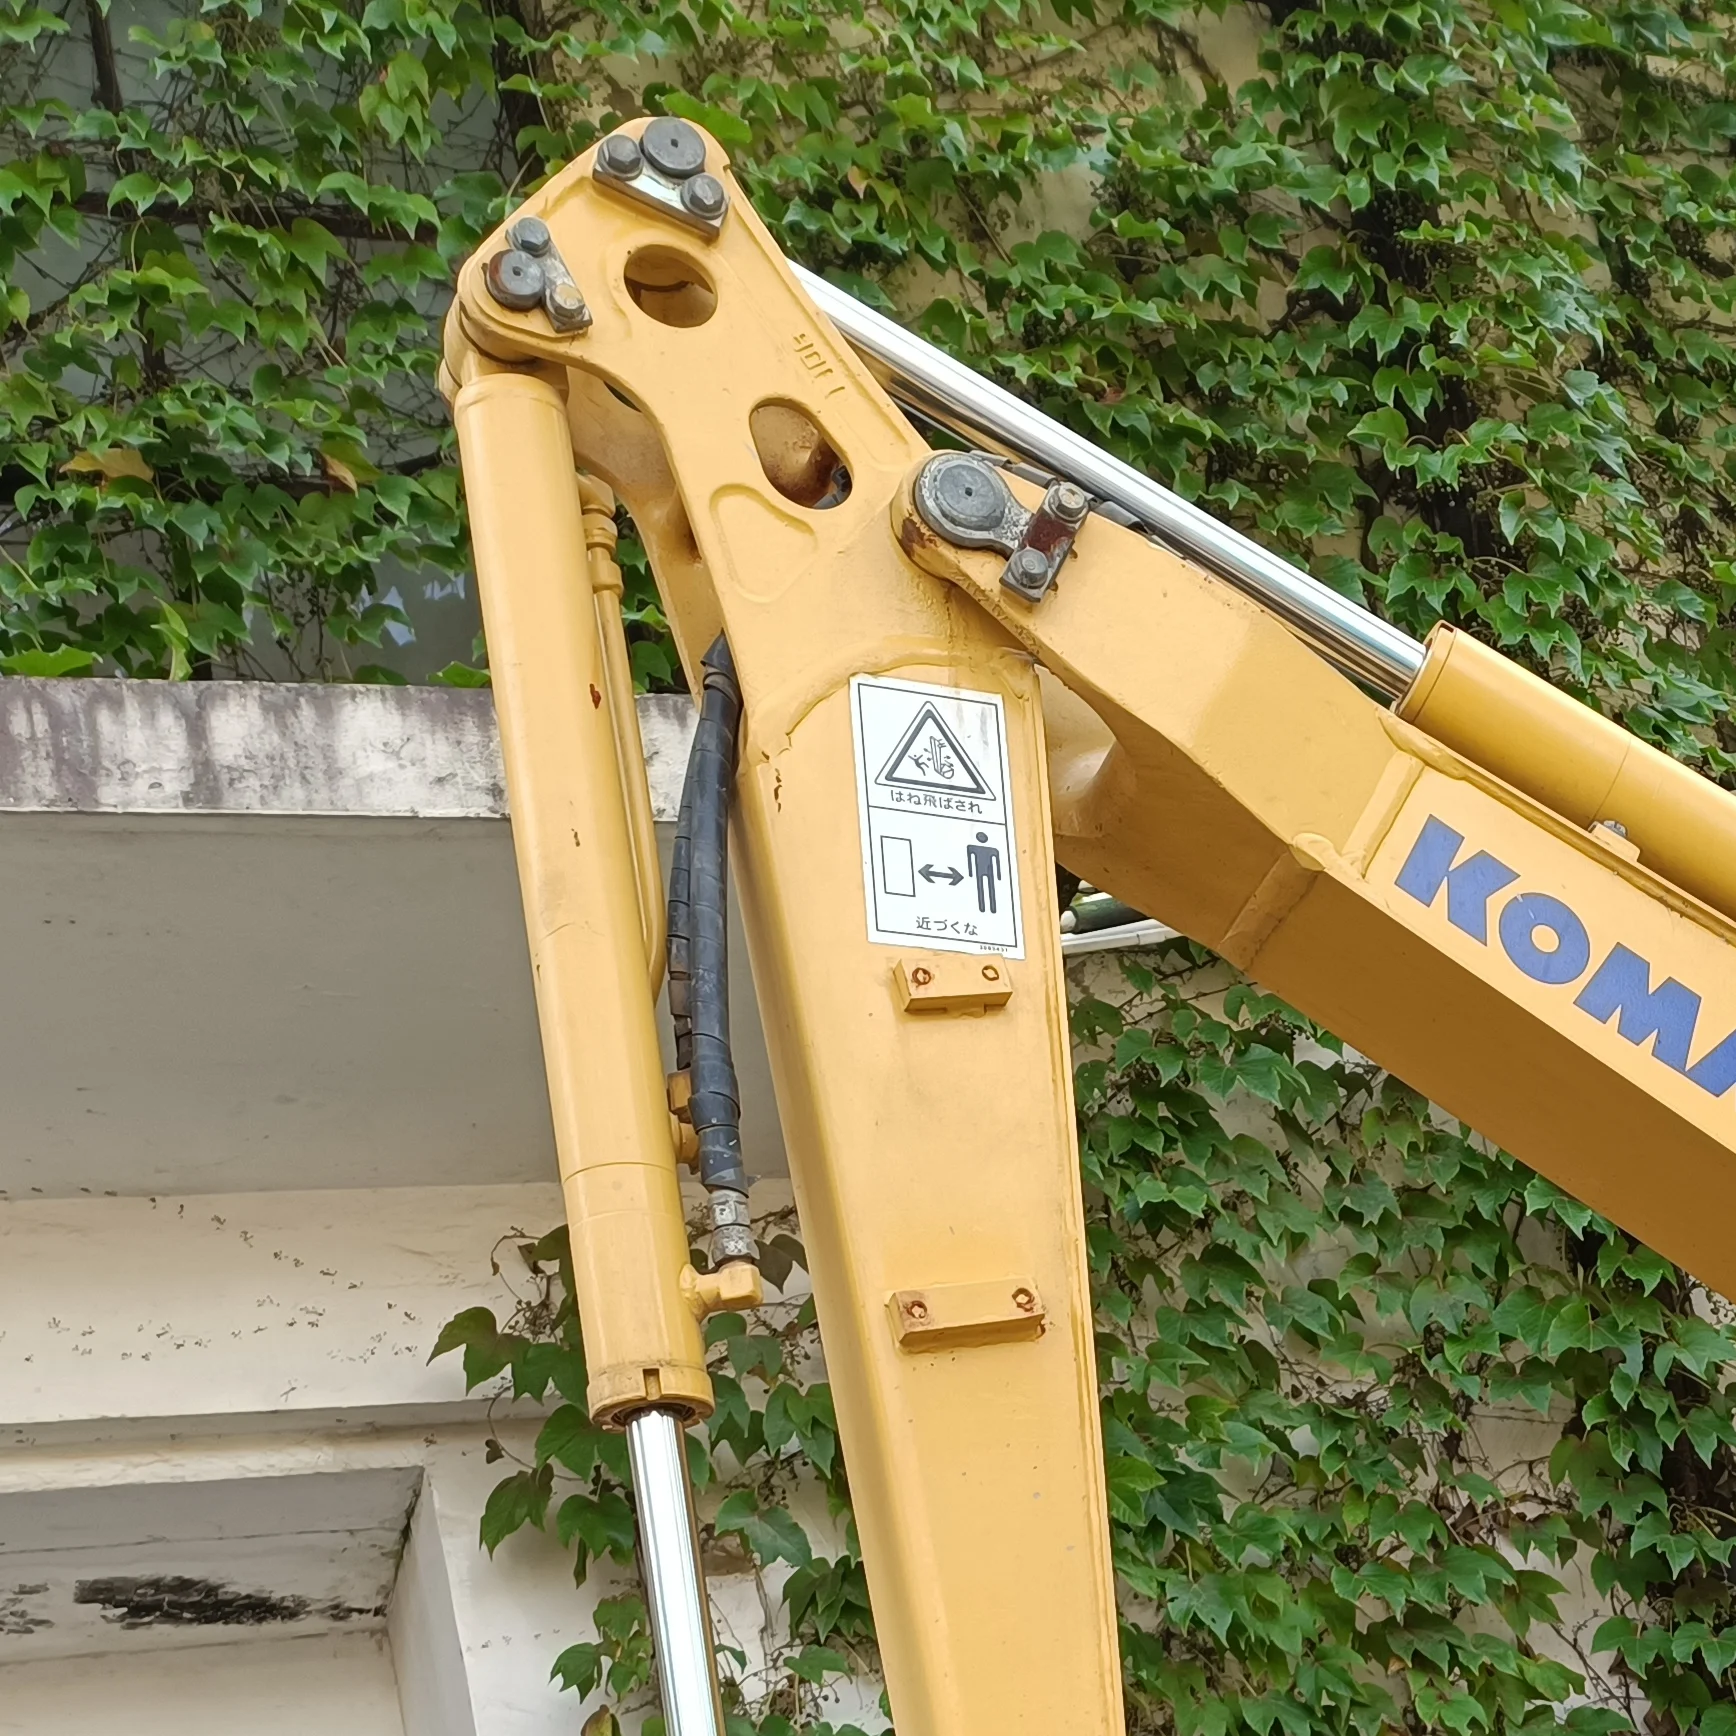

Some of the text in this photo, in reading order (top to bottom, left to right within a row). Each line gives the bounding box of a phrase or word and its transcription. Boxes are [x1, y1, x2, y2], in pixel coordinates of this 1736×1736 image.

[890, 789, 983, 815] はね飛ばされ
[915, 915, 979, 937] 近づくな
